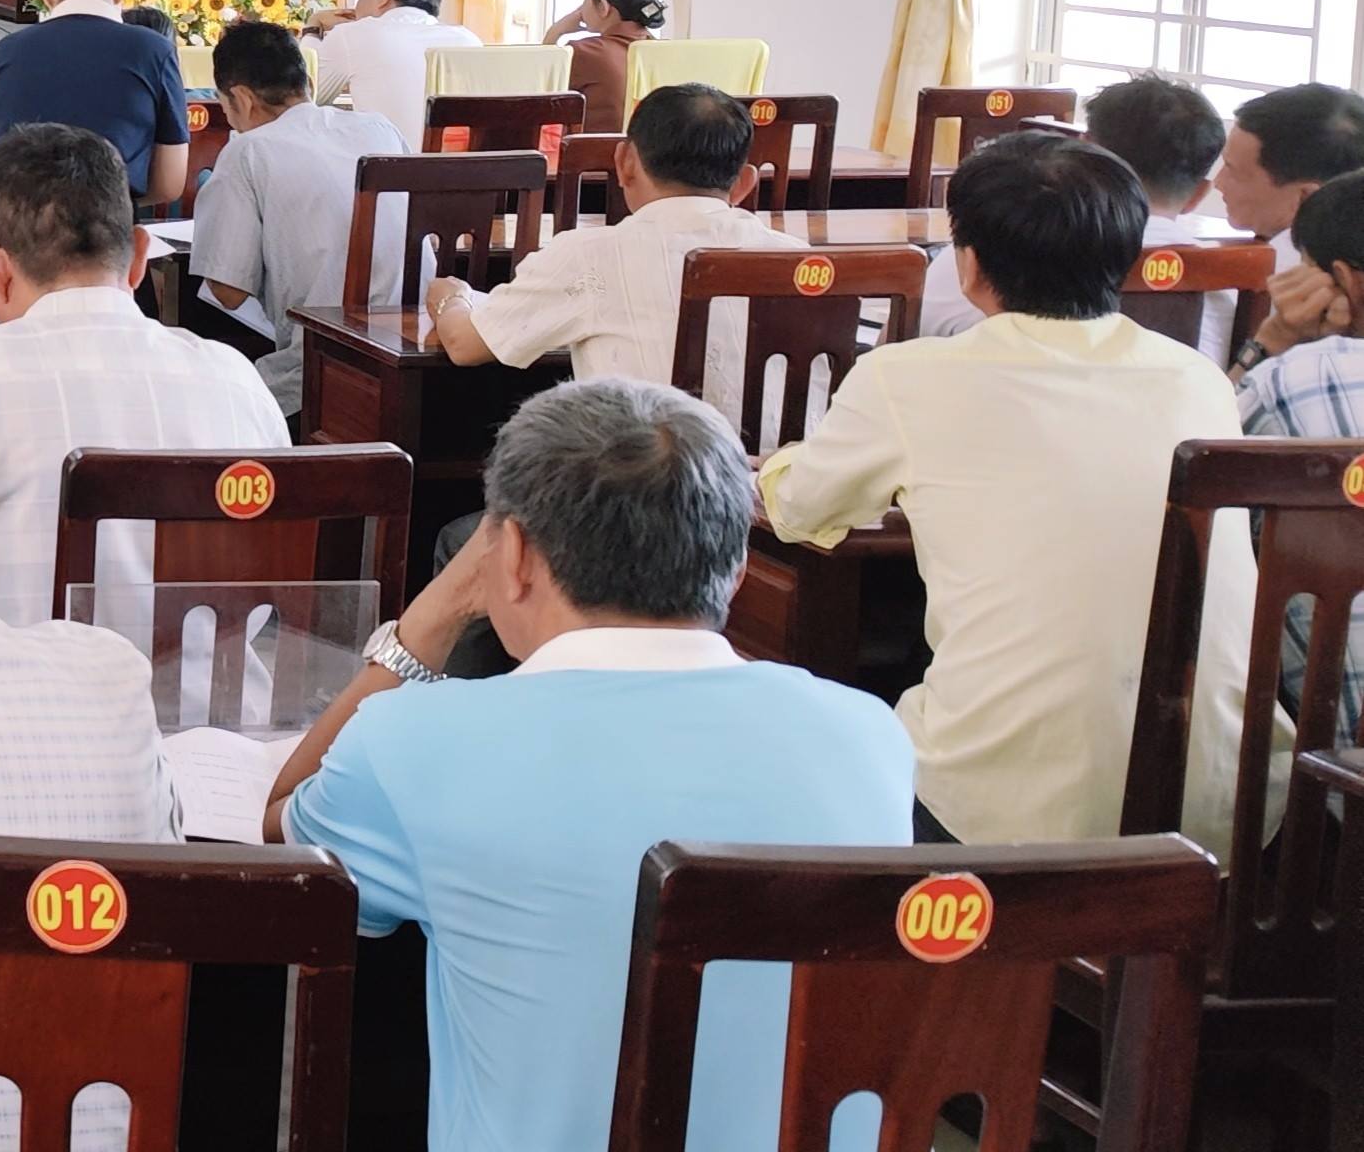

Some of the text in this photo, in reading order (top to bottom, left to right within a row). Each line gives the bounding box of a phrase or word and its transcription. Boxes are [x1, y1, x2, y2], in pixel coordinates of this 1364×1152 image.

[752, 105, 776, 119] 010
[988, 95, 1010, 110] 051
[797, 264, 831, 288] 088
[1147, 259, 1179, 281] 094
[221, 474, 268, 506] 003
[33, 883, 116, 932] 012
[905, 893, 982, 942] 002
